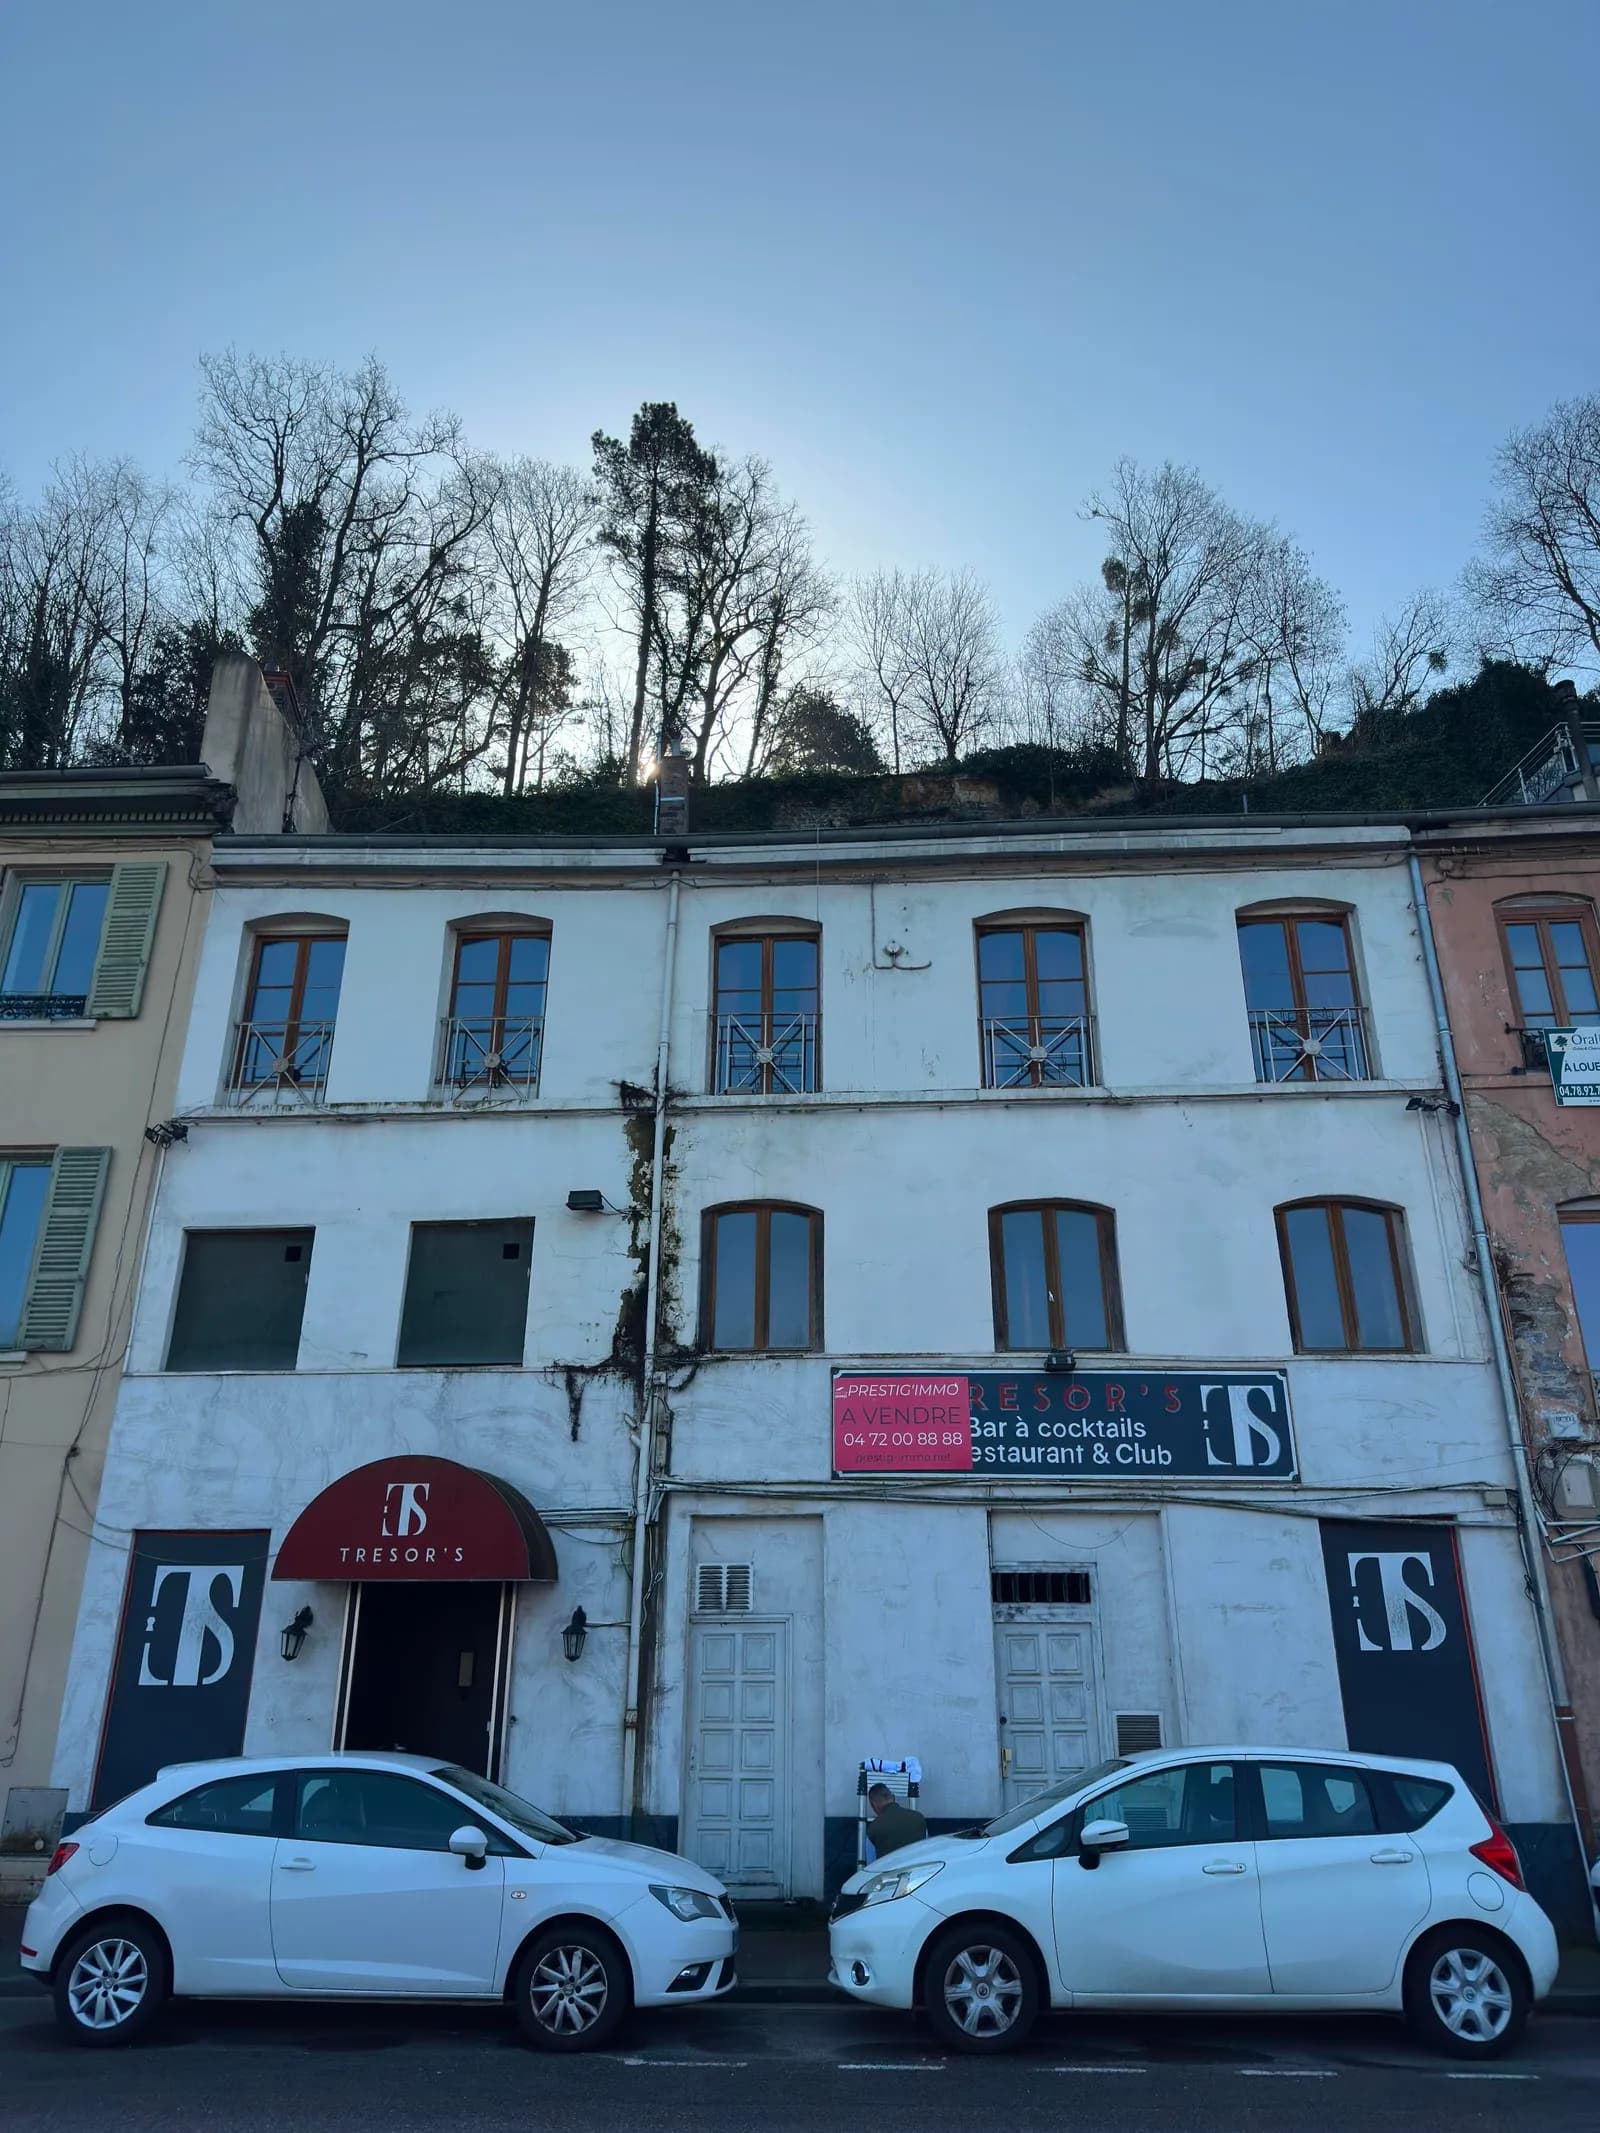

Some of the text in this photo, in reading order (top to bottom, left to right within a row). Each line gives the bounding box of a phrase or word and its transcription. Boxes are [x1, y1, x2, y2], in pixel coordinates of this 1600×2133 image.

[848, 1383, 959, 1397] PRESTIG'IMMO
[969, 1383, 1182, 1413] RESOR'S
[841, 1406, 962, 1425] A VENDRE
[970, 1416, 1147, 1438] Bar à cocktails
[844, 1432, 963, 1446] 04 72 00 88 88
[972, 1443, 1173, 1465] estaurant & Club
[340, 1547, 464, 1563] TRESOR'S
